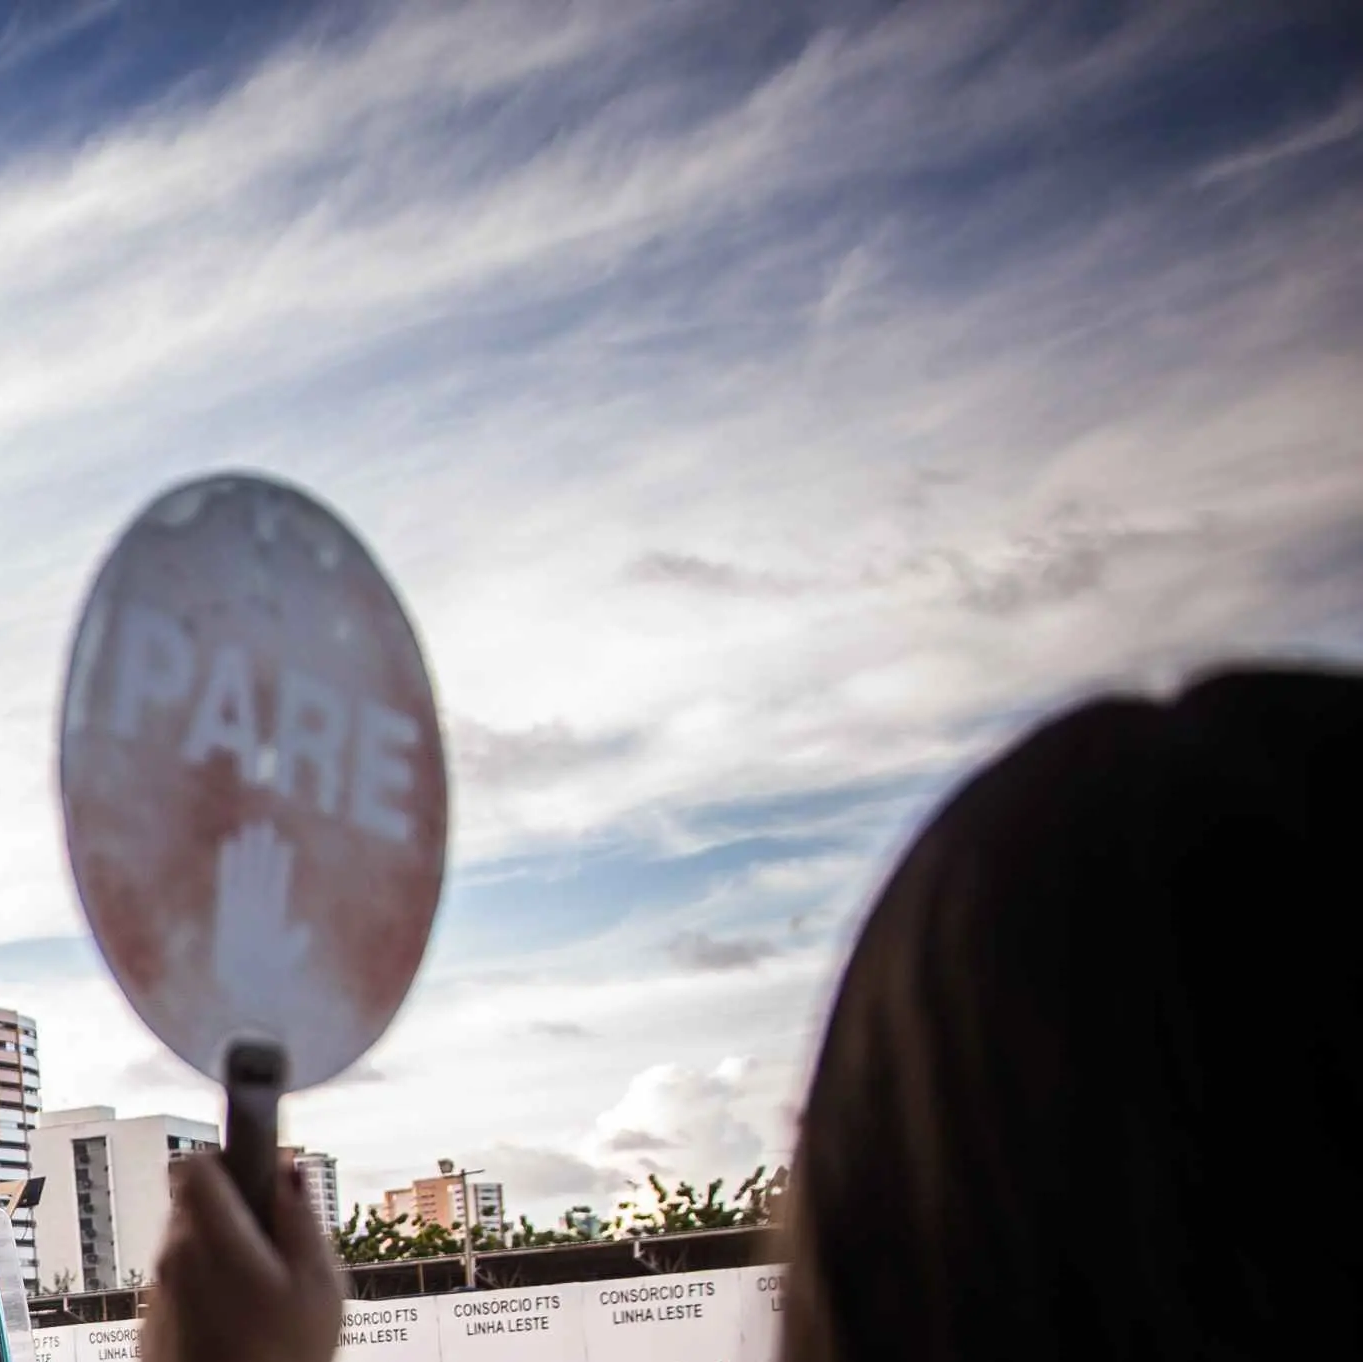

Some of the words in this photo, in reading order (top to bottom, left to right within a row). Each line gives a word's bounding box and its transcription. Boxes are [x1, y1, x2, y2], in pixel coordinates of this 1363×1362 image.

[110, 605, 422, 843] PARE
[688, 1281, 715, 1297] FTS
[535, 1295, 561, 1310] FTS
[395, 1308, 418, 1322] FTS
[612, 1308, 655, 1325] LINHA
[658, 1303, 704, 1321] LESTE
[466, 1320, 505, 1336] LINHA
[508, 1316, 550, 1333] LESTE
[43, 1336, 60, 1348] FTS
[340, 1331, 368, 1347] INHA
[370, 1328, 409, 1344] LESTE
[99, 1347, 130, 1360] LINHA
